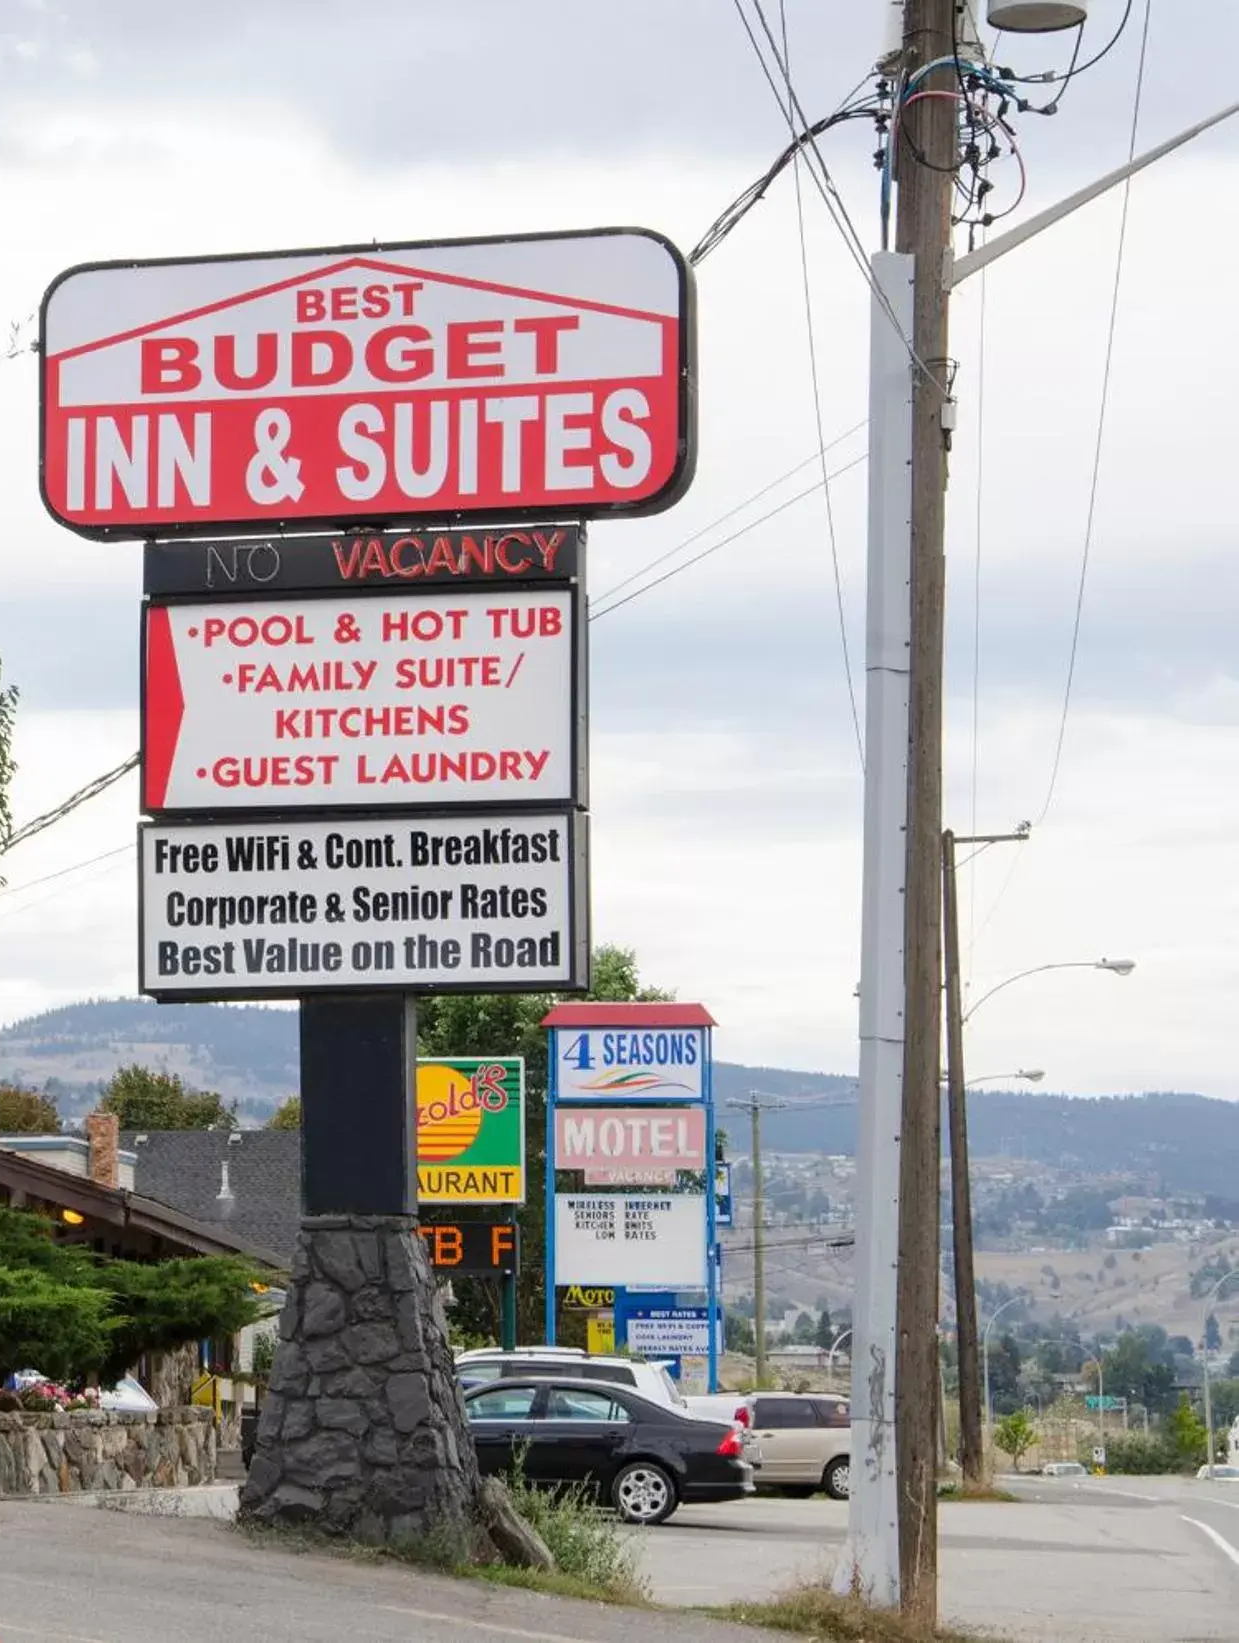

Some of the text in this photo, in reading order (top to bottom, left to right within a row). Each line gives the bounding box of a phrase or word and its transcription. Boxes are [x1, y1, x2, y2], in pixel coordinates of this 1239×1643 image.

[296, 282, 423, 324] BEST
[140, 315, 580, 394] BUDGET
[66, 388, 653, 511] INN & SUITES
[206, 531, 566, 588] NO VACANCY
[204, 606, 562, 647] POOL & HOT TUB
[238, 660, 378, 692] FAMILY
[275, 704, 469, 739] KITCHENS
[212, 750, 550, 787] GUEST LAUNDRY
[155, 828, 560, 874] Free WiFi & Cont. Breakfast
[167, 884, 546, 929] Corporate & Senior Rates
[159, 931, 560, 976] Best Value on the Road
[563, 1033, 696, 1070] 4 SEASONS
[564, 1117, 699, 1157] MOTEL
[567, 1200, 671, 1210] WIRELESS INTERNET
[574, 1211, 648, 1220] SENIORS RATE
[575, 1221, 615, 1230] KITCHEN
[625, 1231, 656, 1240] RATES
